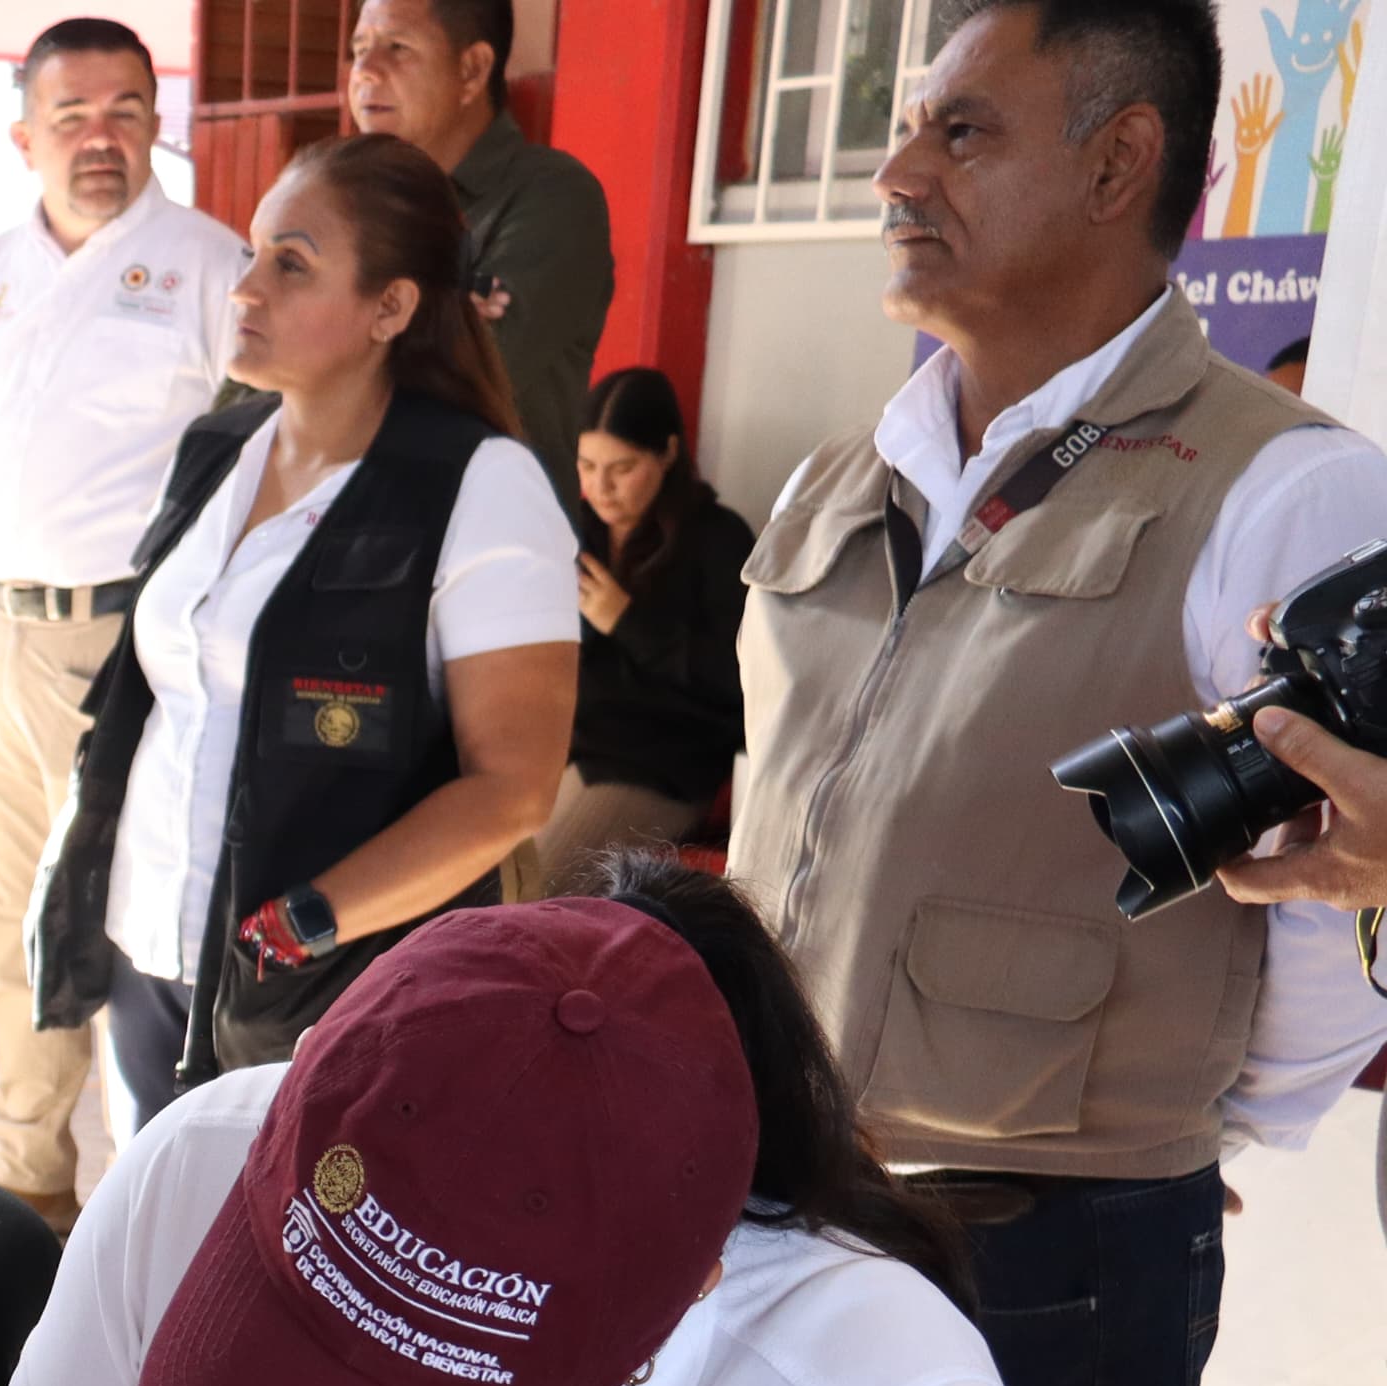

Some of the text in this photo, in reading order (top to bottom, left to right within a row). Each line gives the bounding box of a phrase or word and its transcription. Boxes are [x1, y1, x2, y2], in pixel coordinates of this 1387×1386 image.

[1227, 268, 1320, 304] Cháv
[308, 1243, 501, 1369] COORDINACIÓN NACIONAL
[340, 1213, 539, 1328] SECRETARÍA DE EDUCACIÓN PÚBLICA
[355, 1193, 552, 1306] EDUCACIÓN
[295, 1254, 514, 1386] DE BECAS PARA EL BIENESTAR
